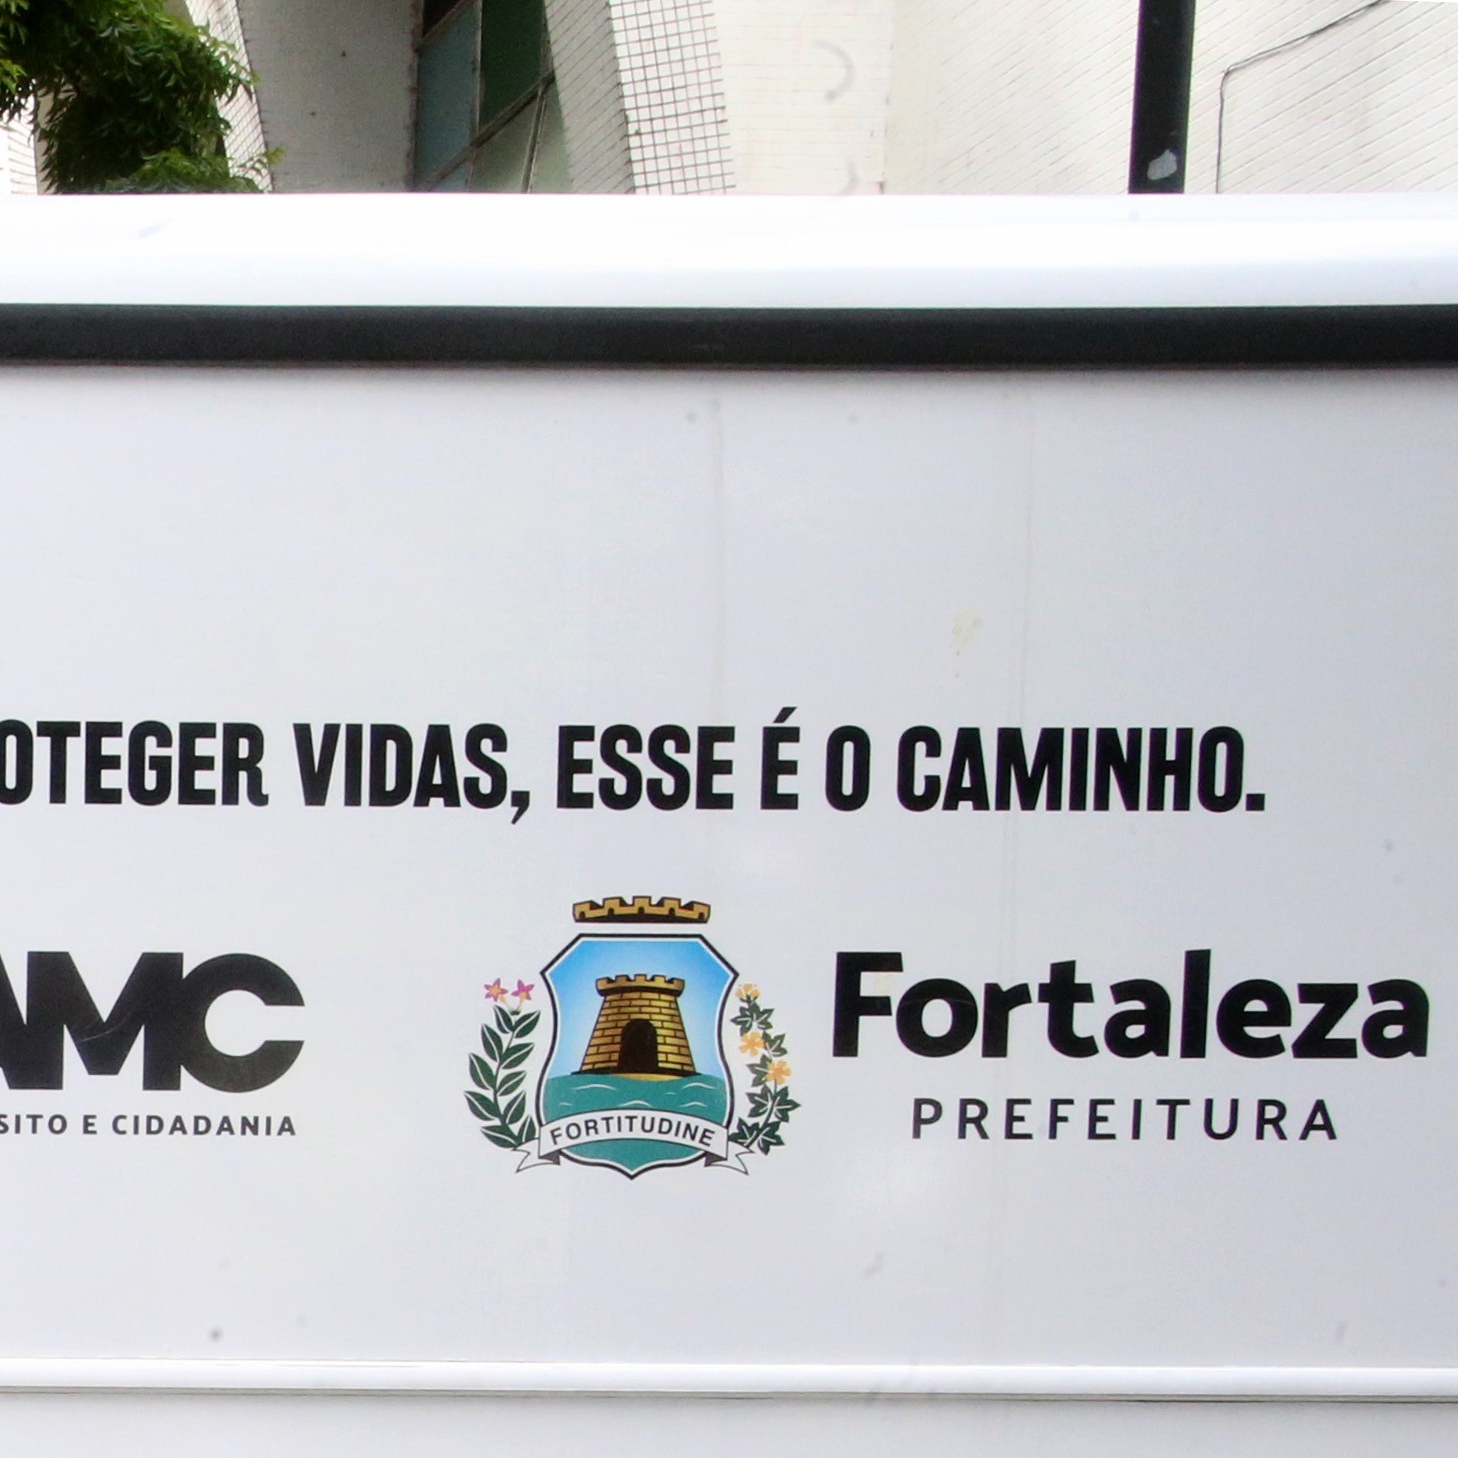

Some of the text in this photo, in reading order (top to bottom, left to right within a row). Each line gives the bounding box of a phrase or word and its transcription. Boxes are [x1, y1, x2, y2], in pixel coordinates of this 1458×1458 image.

[293, 723, 530, 824] VIDAS,
[557, 724, 735, 811] ESSE
[761, 707, 800, 810] É
[826, 725, 871, 811] O
[897, 726, 1265, 813] CAMINHO.
[833, 949, 1430, 1059] Fortaleza
[83, 1115, 97, 1134] E
[112, 1115, 295, 1135] CIDADANIA
[550, 1115, 716, 1147] FORTITUDINE
[913, 1098, 1337, 1140] PREFEITURA
